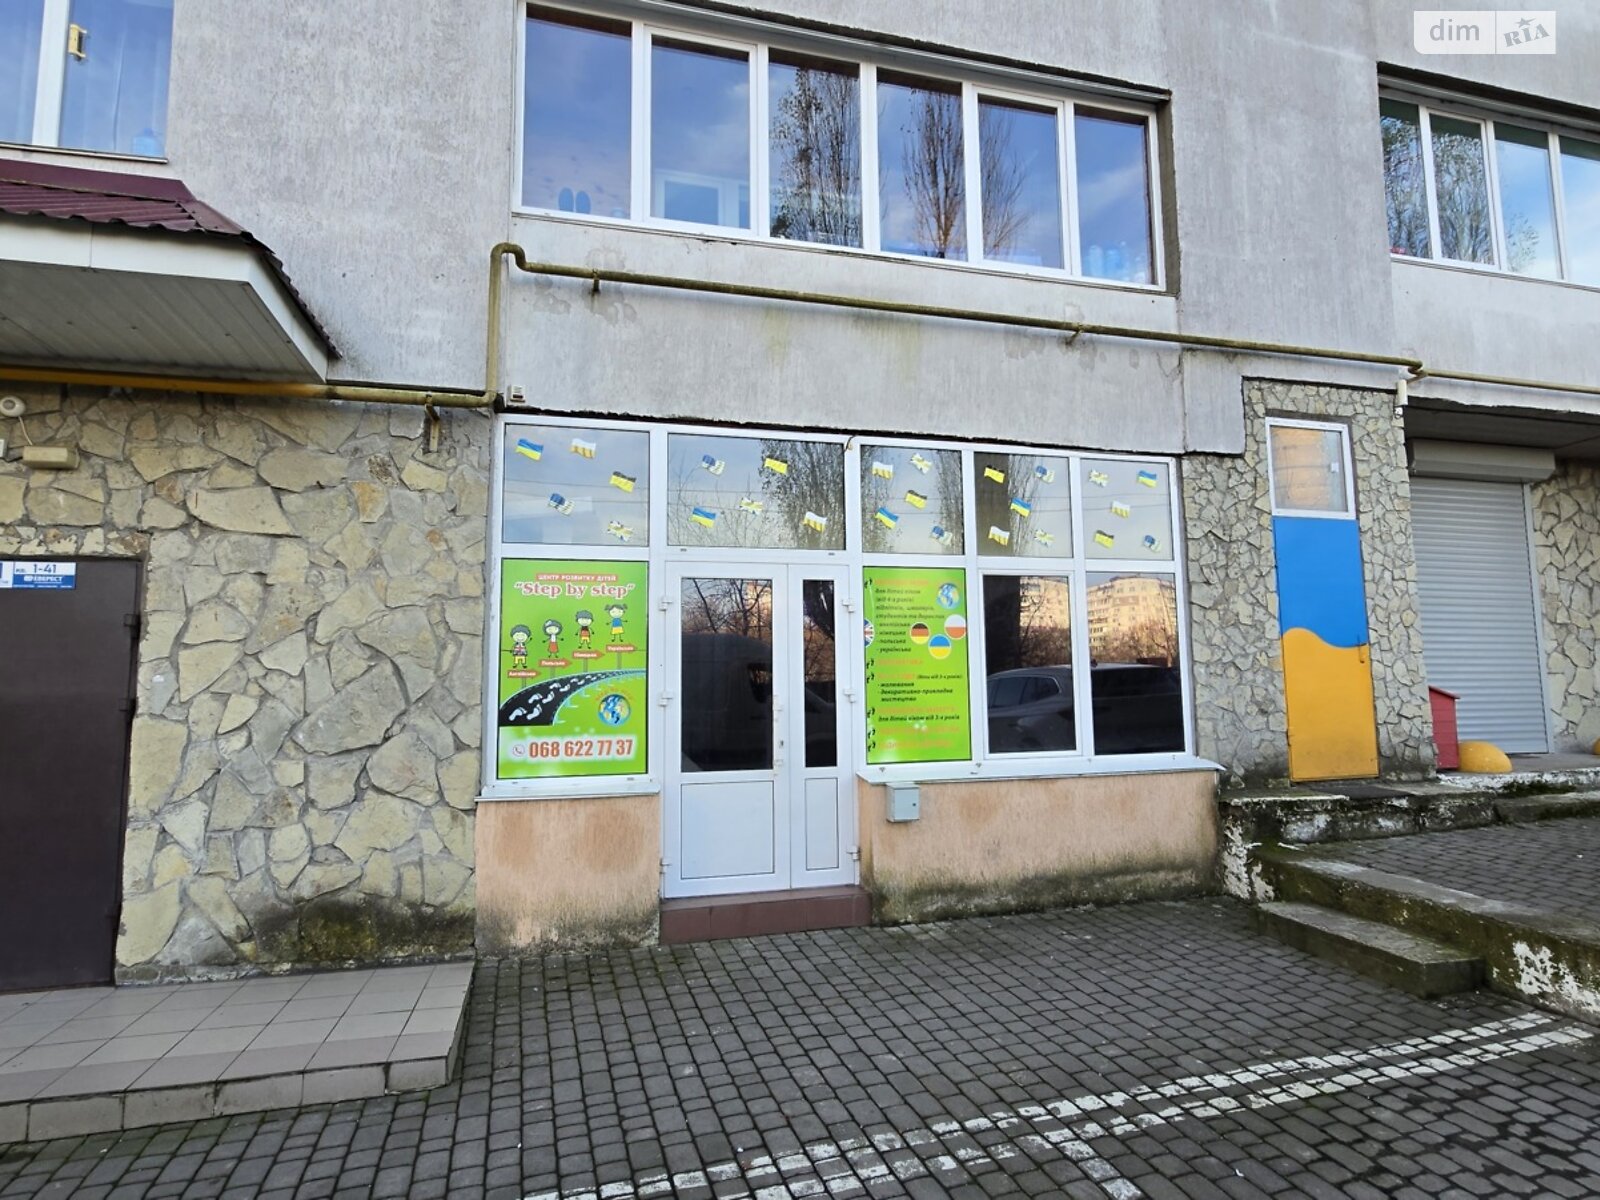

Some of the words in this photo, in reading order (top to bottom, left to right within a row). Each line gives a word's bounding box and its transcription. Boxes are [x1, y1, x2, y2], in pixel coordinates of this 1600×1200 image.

[33, 563, 57, 573] 1-41
[567, 582, 587, 598] by
[529, 741, 560, 758] 068
[564, 740, 593, 758] 622
[597, 739, 613, 757] 77
[616, 739, 633, 756] 37
